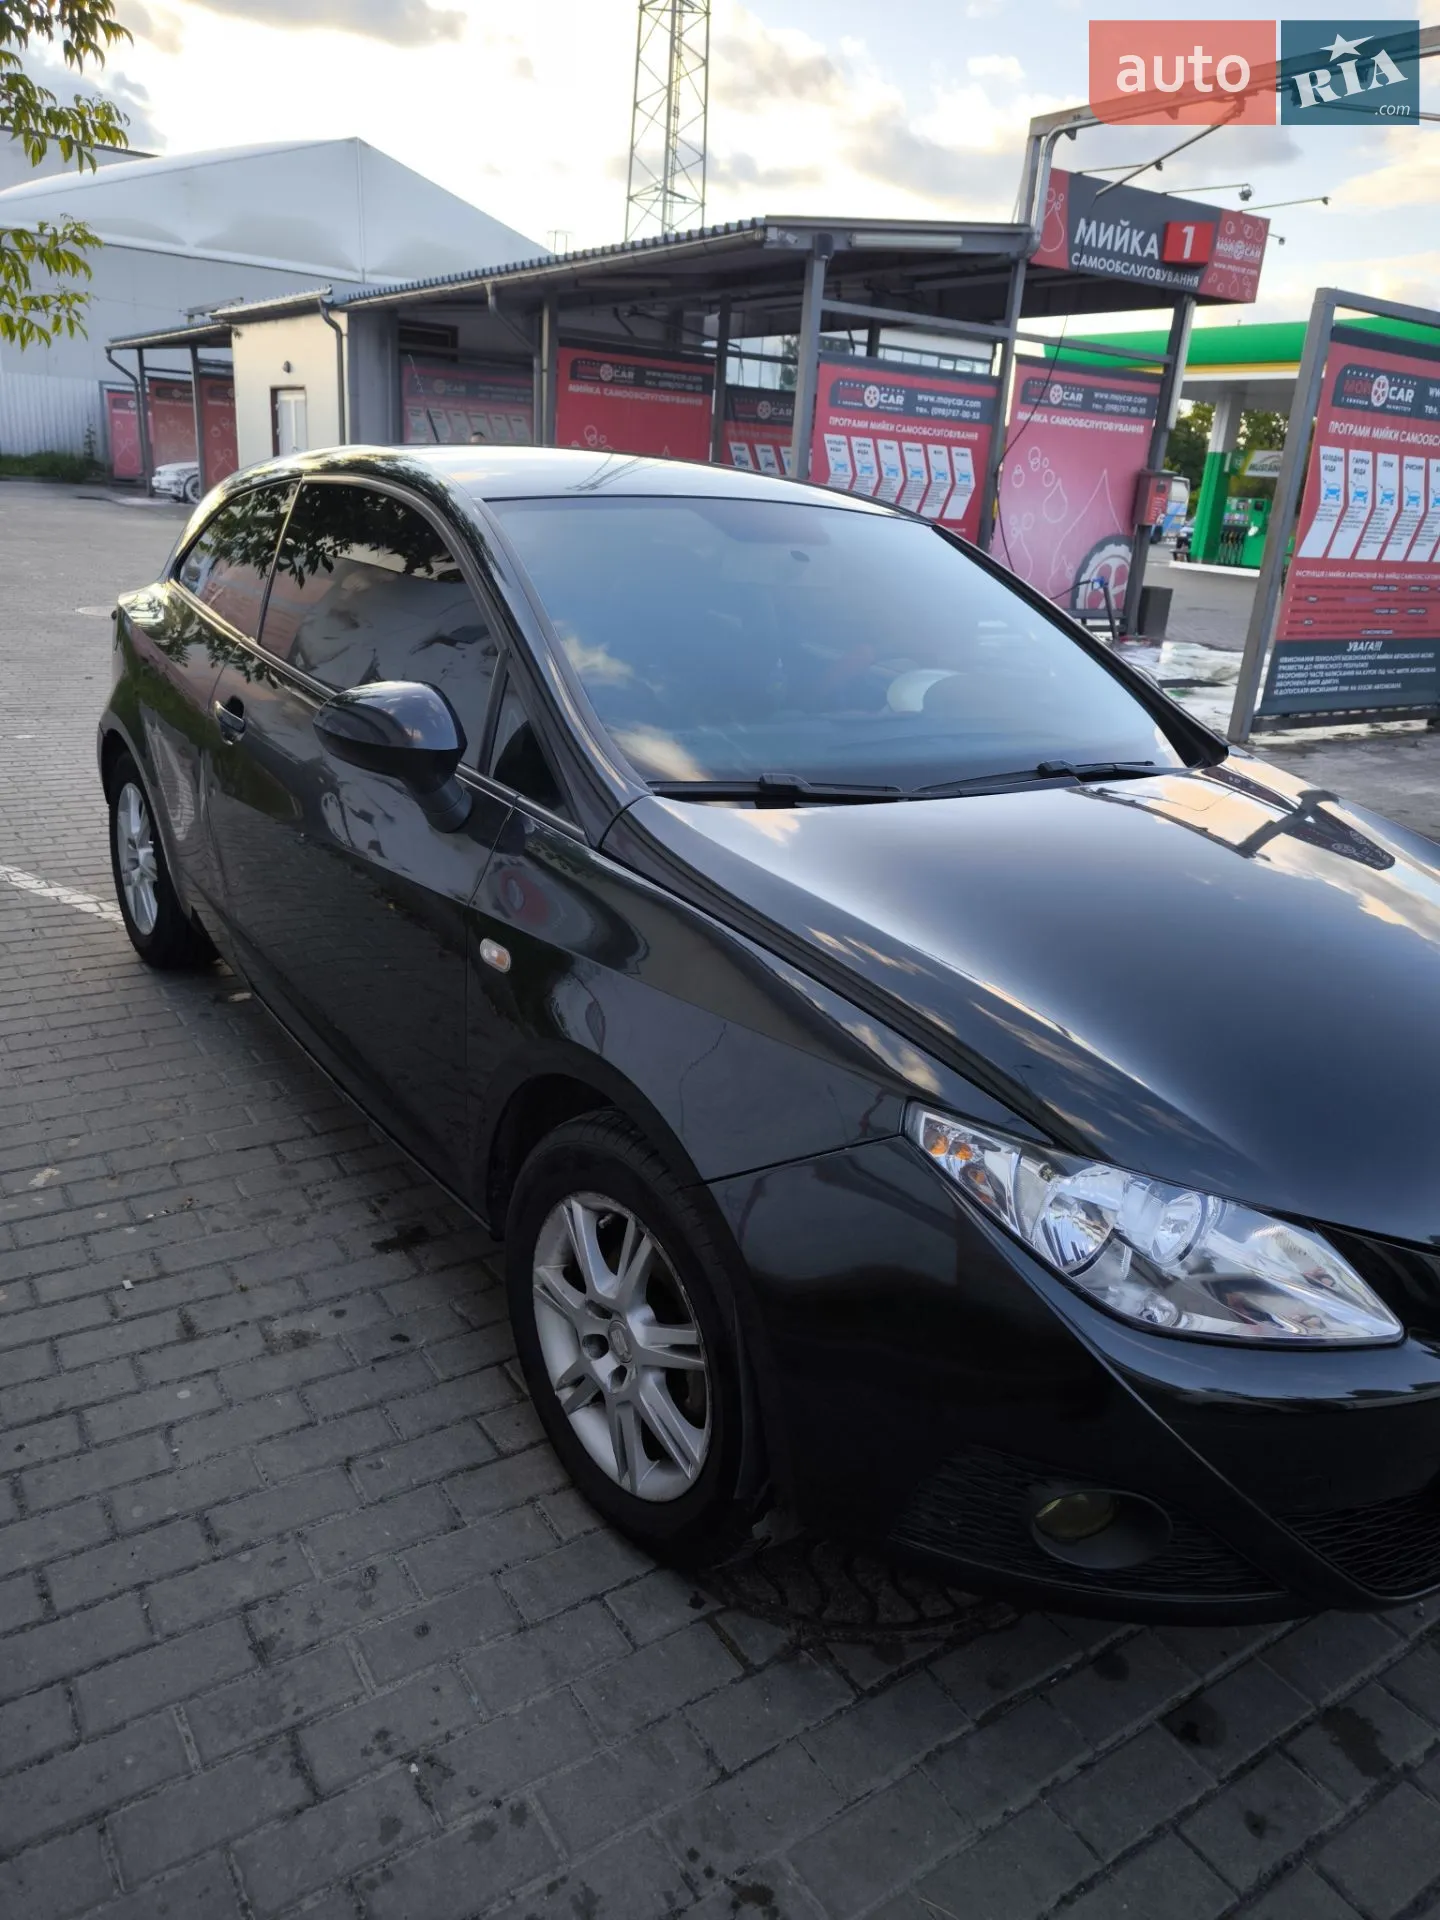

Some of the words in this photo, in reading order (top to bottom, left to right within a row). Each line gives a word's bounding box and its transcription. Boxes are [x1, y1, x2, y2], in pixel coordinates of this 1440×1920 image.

[1074, 217, 1159, 260] МИЙКА
[1182, 226, 1196, 259] 1
[1071, 252, 1199, 288] САМООБСЛУГОВУВАННЯ
[880, 393, 905, 405] CAR
[1063, 391, 1083, 402] CAR
[1389, 386, 1414, 403] CAR
[829, 416, 869, 430] ПРОГРАМИ
[870, 419, 895, 431] МИЙКИ
[895, 424, 979, 441] САМООБСЛУГОВУВАННЯ
[1017, 411, 1048, 423] МИЙКА
[1050, 415, 1144, 433] САМООБСЛУГОВУВАННЯ
[1328, 420, 1371, 437] ПРОГРАМИ
[1372, 426, 1400, 441] МИЙКИ
